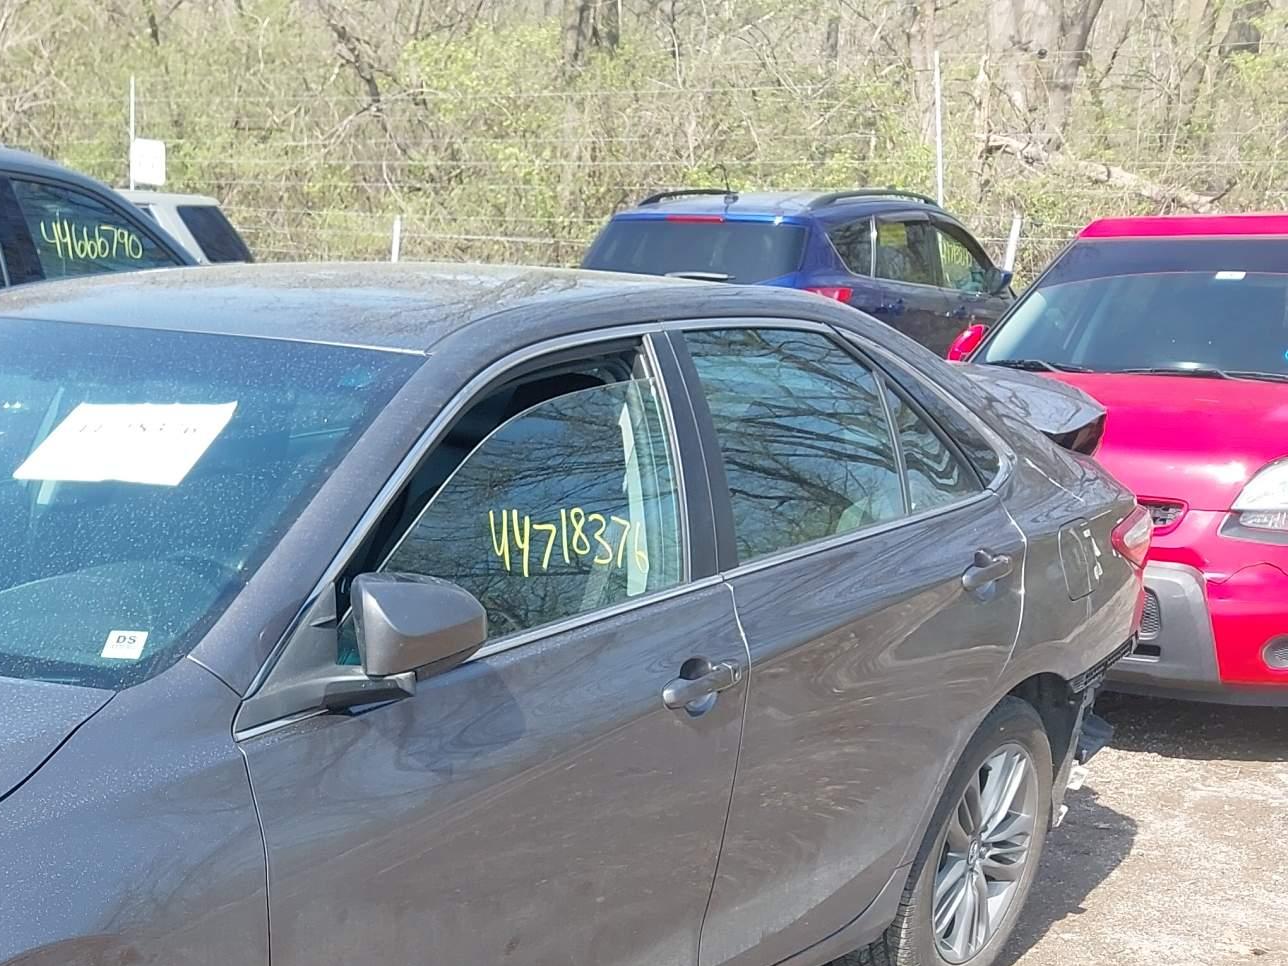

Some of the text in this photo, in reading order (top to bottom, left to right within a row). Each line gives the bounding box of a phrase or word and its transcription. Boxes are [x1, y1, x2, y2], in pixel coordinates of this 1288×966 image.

[40, 219, 143, 260] 44666790
[489, 507, 650, 578] 44718376
[116, 635, 137, 644] DS
